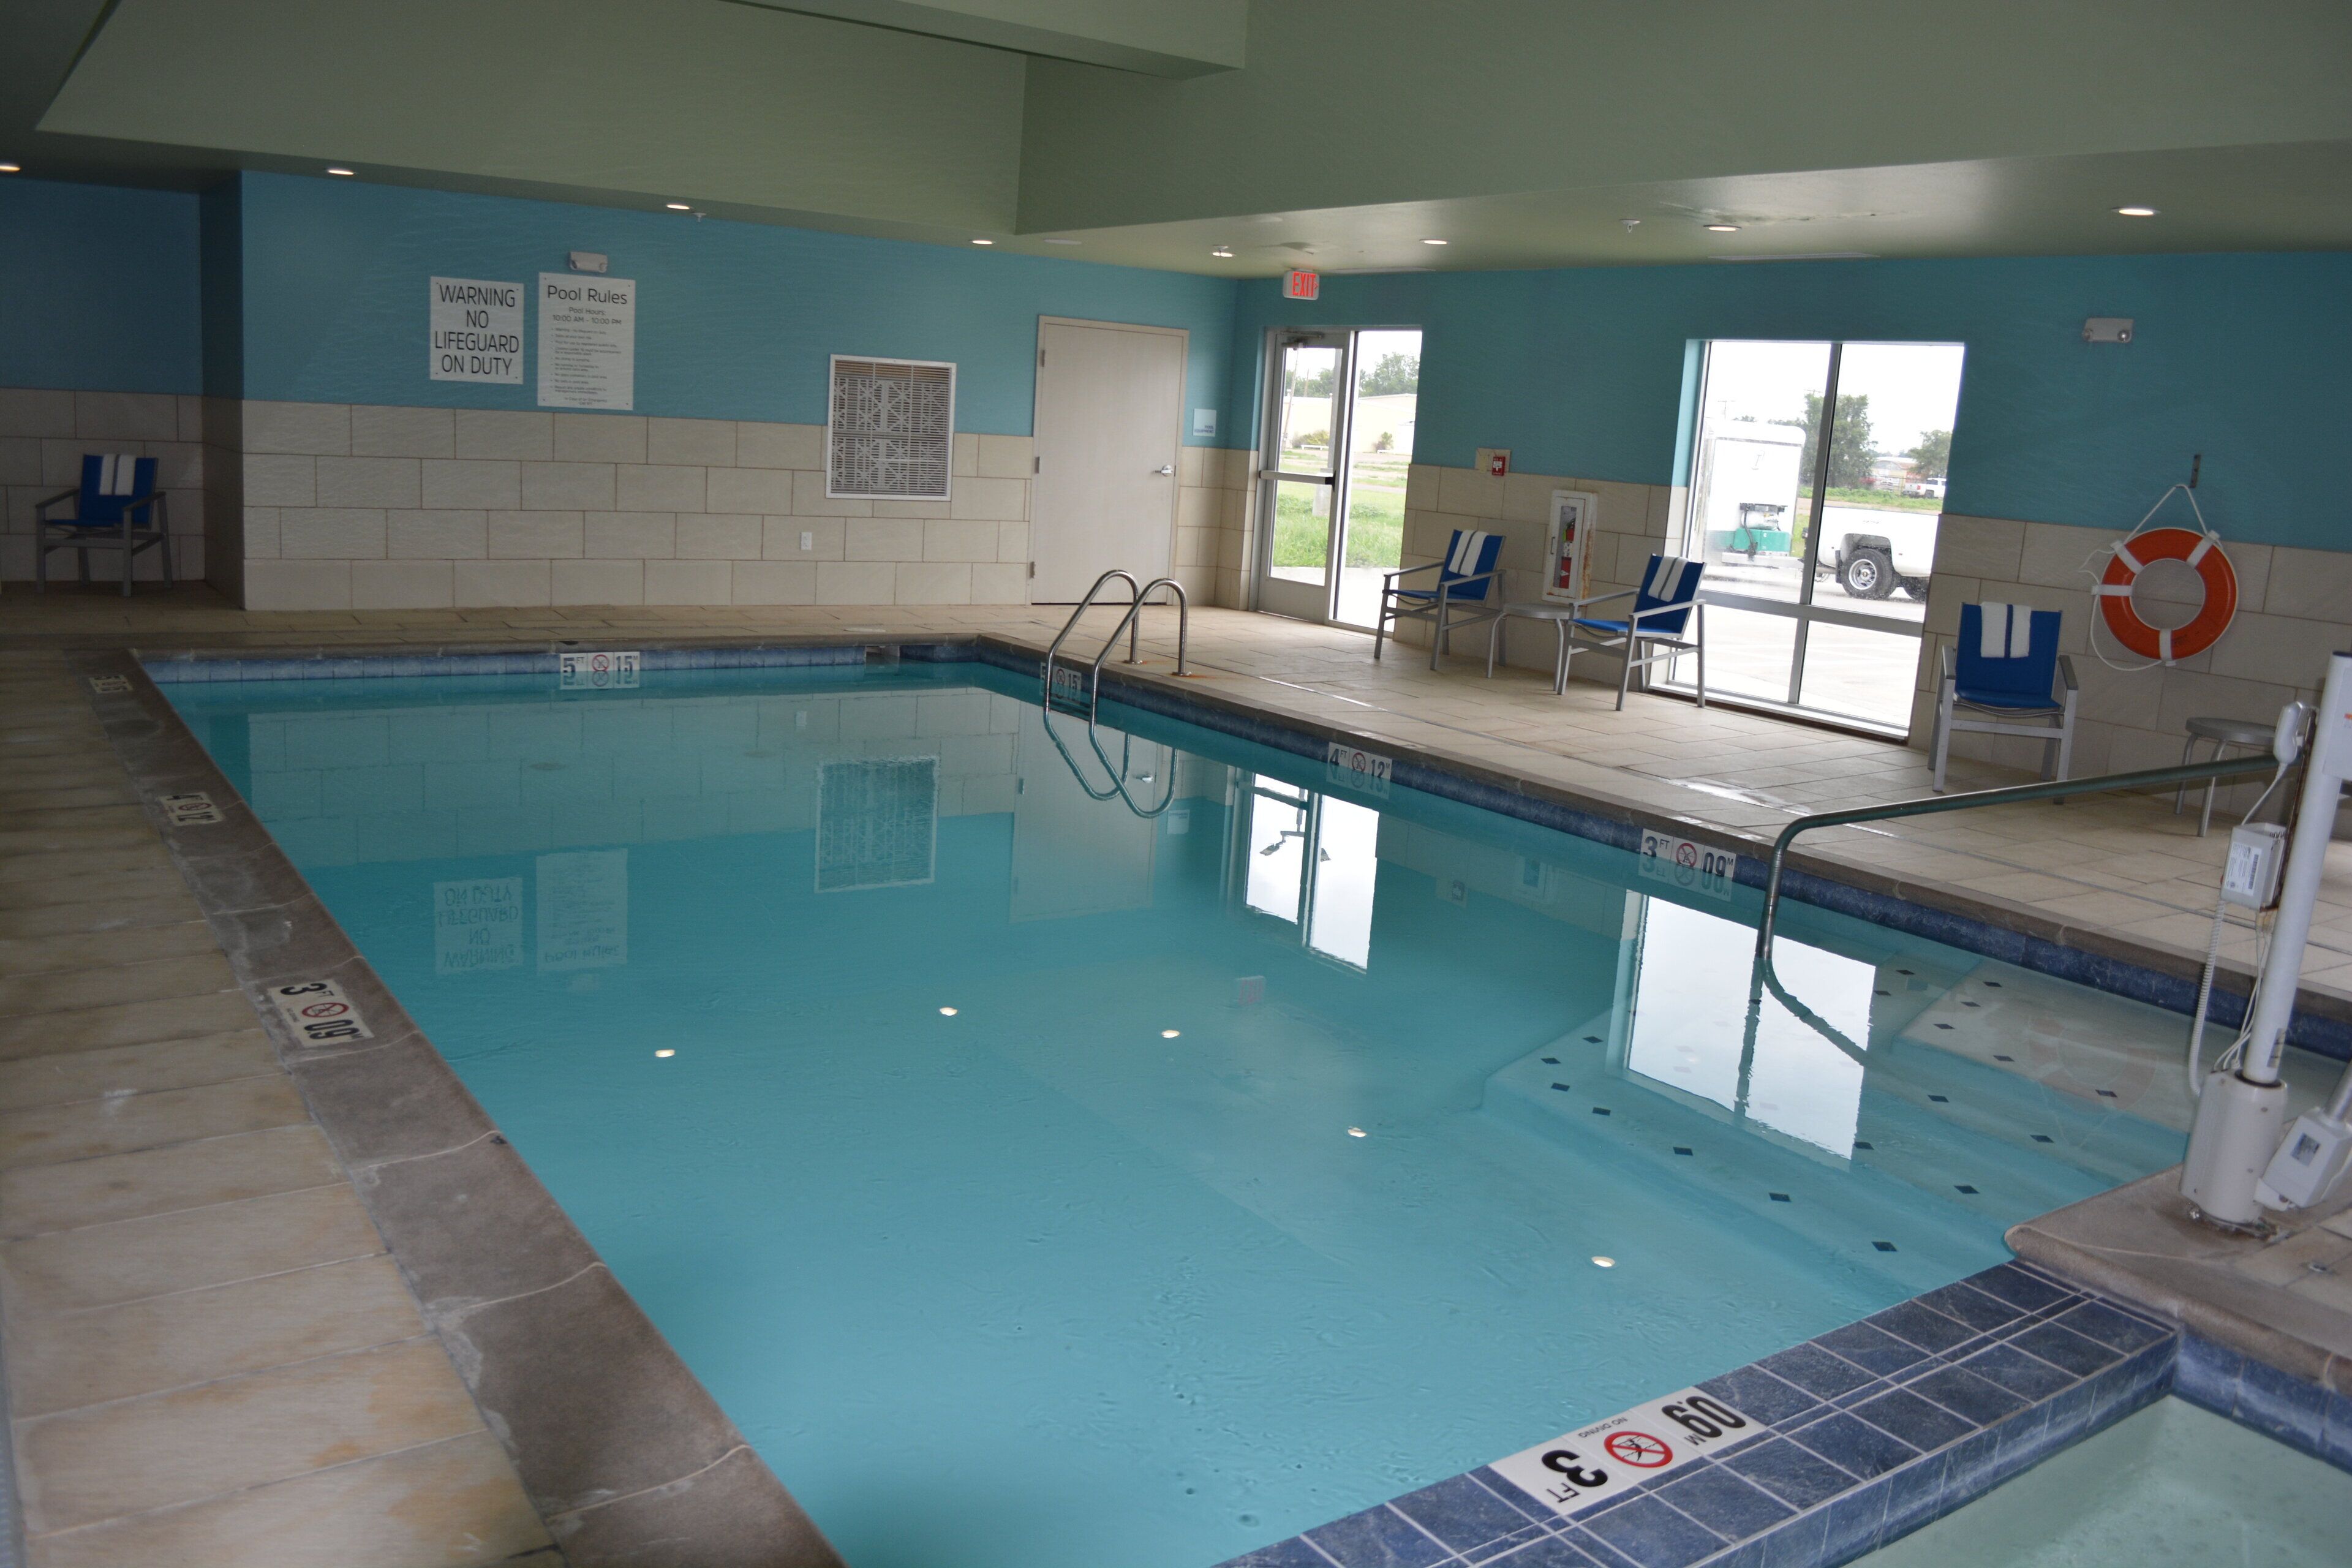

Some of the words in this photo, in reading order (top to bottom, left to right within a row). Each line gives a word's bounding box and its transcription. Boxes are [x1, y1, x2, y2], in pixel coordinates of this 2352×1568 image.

[1292, 271, 1316, 297] EXIT
[439, 284, 515, 307] WARNING
[548, 285, 581, 301] Pool
[588, 288, 628, 304] Rules
[466, 309, 489, 328] NO
[435, 331, 519, 353] LIFEGUARD
[442, 354, 464, 373] ON
[471, 356, 513, 375] DUTY
[563, 657, 576, 673] 5
[1329, 748, 1340, 766] 4
[1340, 750, 1348, 758] FT
[1643, 836, 1657, 857] 3
[1659, 839, 1670, 850] FT
[1727, 858, 1733, 866] M
[280, 982, 327, 995] 3
[1578, 1423, 1611, 1438] DIVING
[1684, 1433, 1707, 1446] M
[1542, 1449, 1608, 1487] 3
[1547, 1482, 1580, 1503] FT
